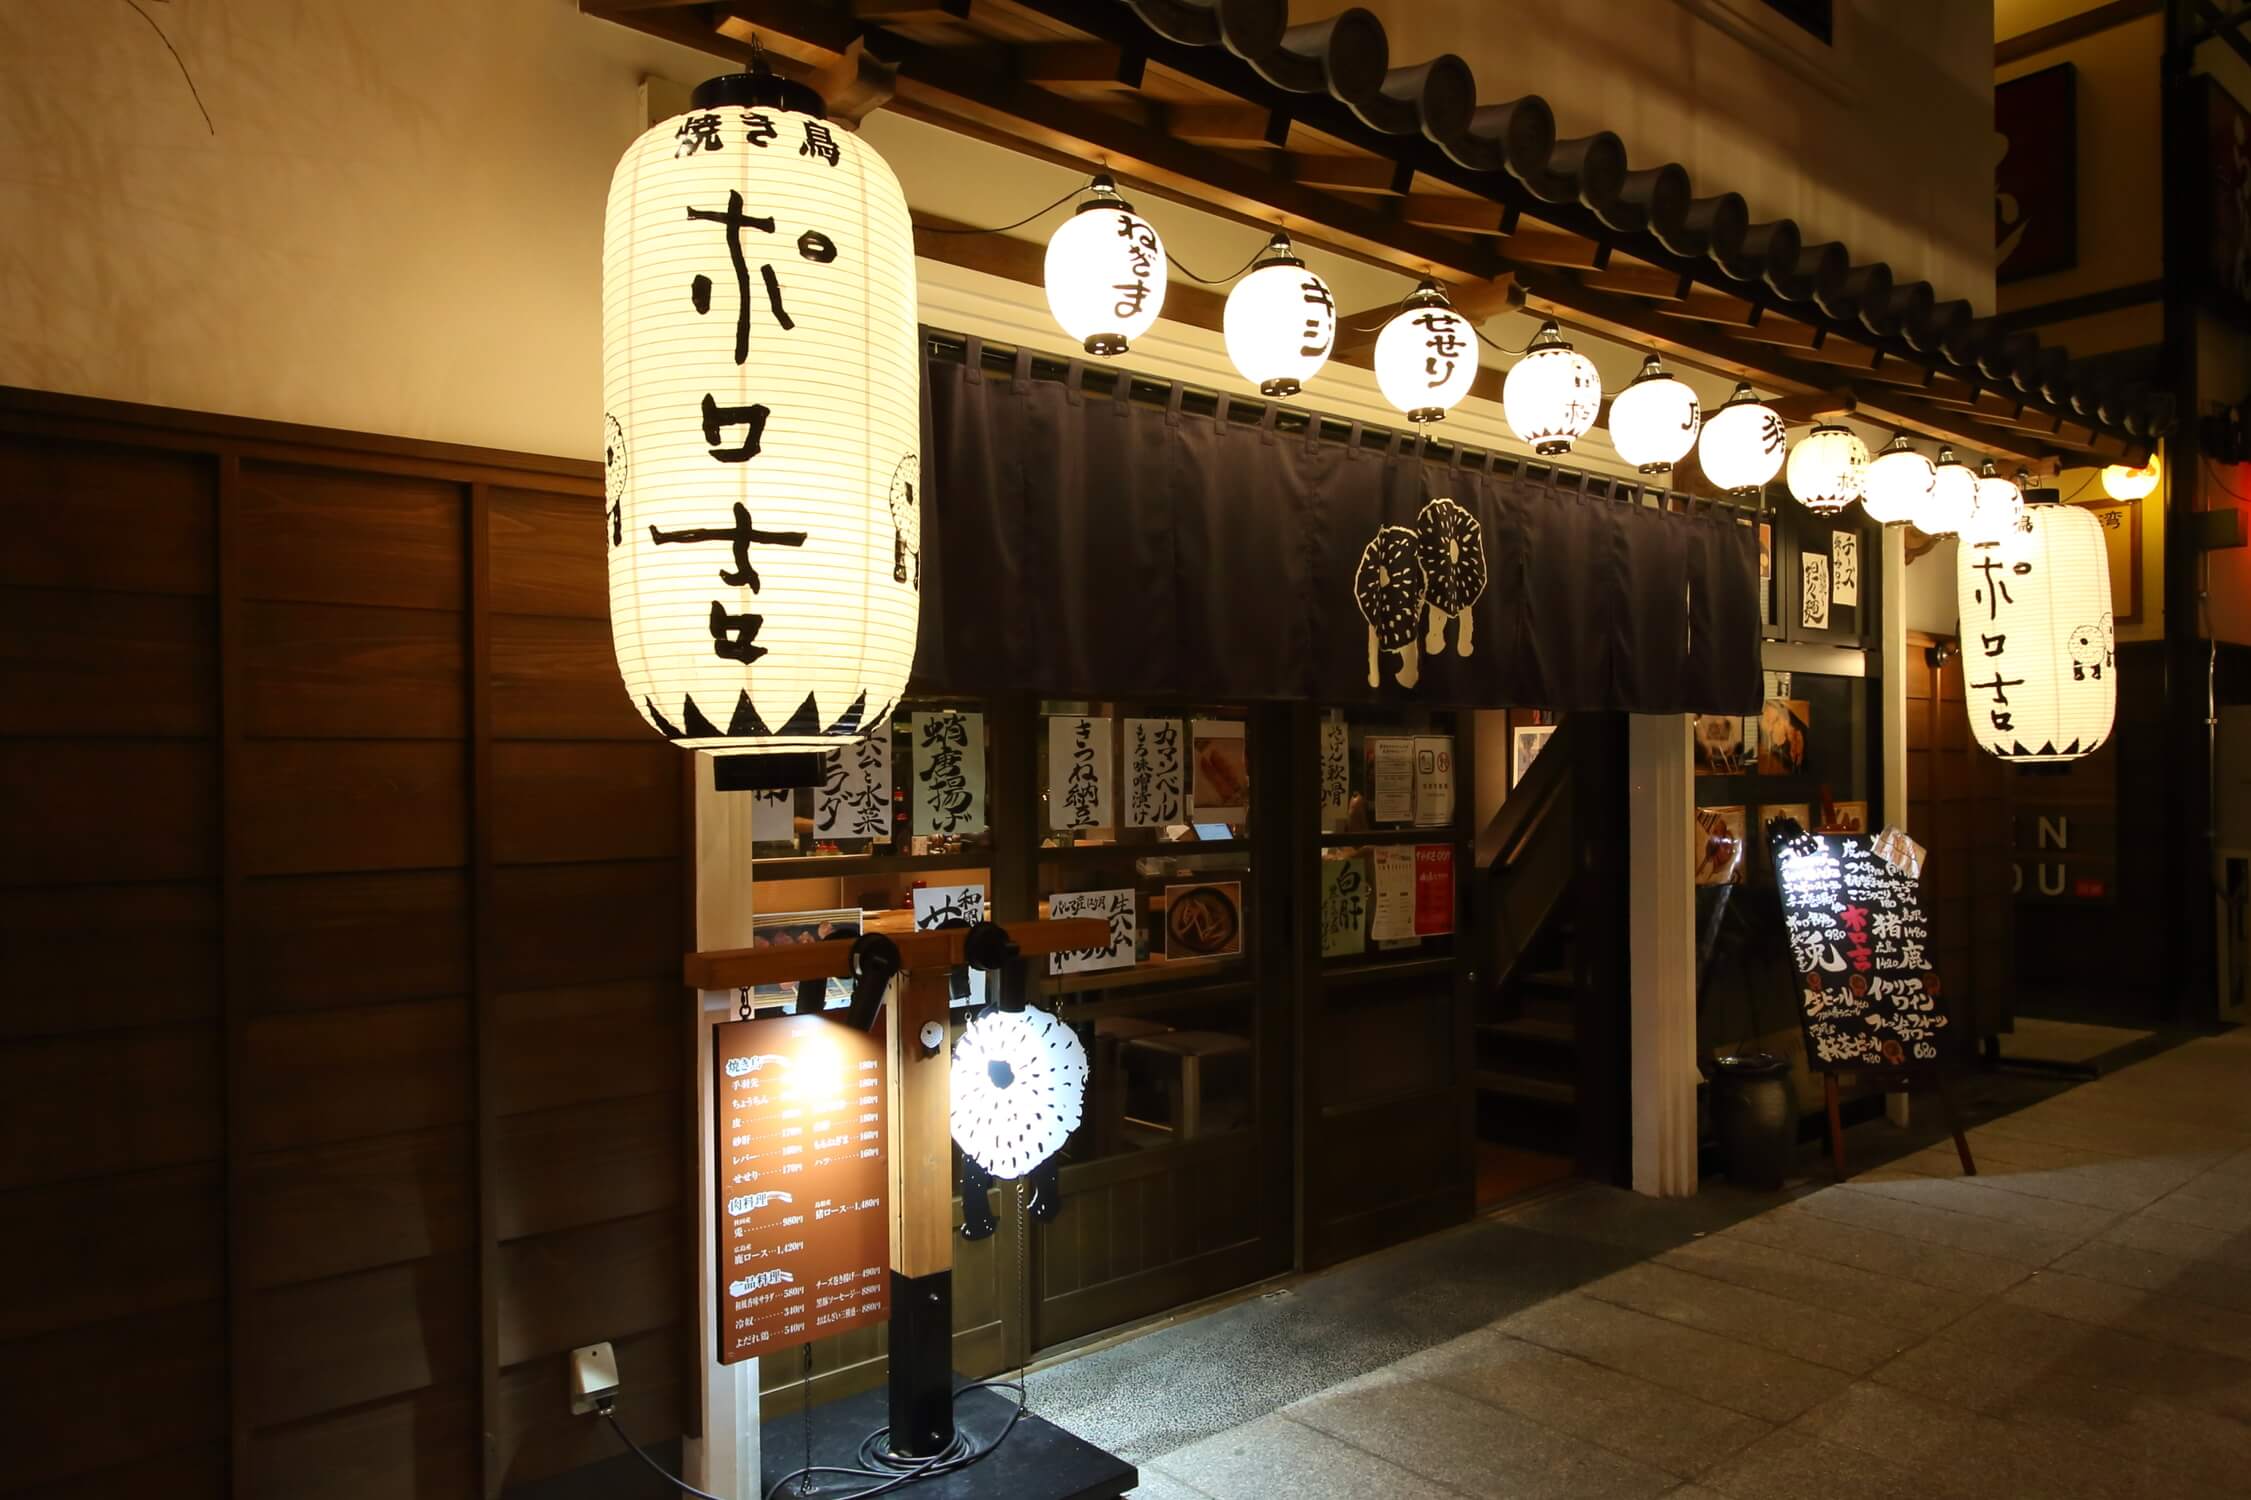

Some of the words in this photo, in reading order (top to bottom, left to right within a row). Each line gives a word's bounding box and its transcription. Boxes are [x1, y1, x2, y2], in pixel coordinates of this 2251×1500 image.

[674, 112, 840, 167] 焼き鳥
[1112, 214, 1158, 319] ねぎま
[1412, 313, 1467, 389] せせり
[849, 735, 890, 836] ハムと水菜
[1063, 719, 1100, 829] きつね納豆
[1335, 861, 1364, 931] 白肝
[1871, 910, 1904, 940] 猪
[1896, 939, 1933, 971] 鹿
[1867, 976, 1924, 1001] イタリア
[1891, 993, 1935, 1012] ワイン
[1912, 1042, 1937, 1060] 680
